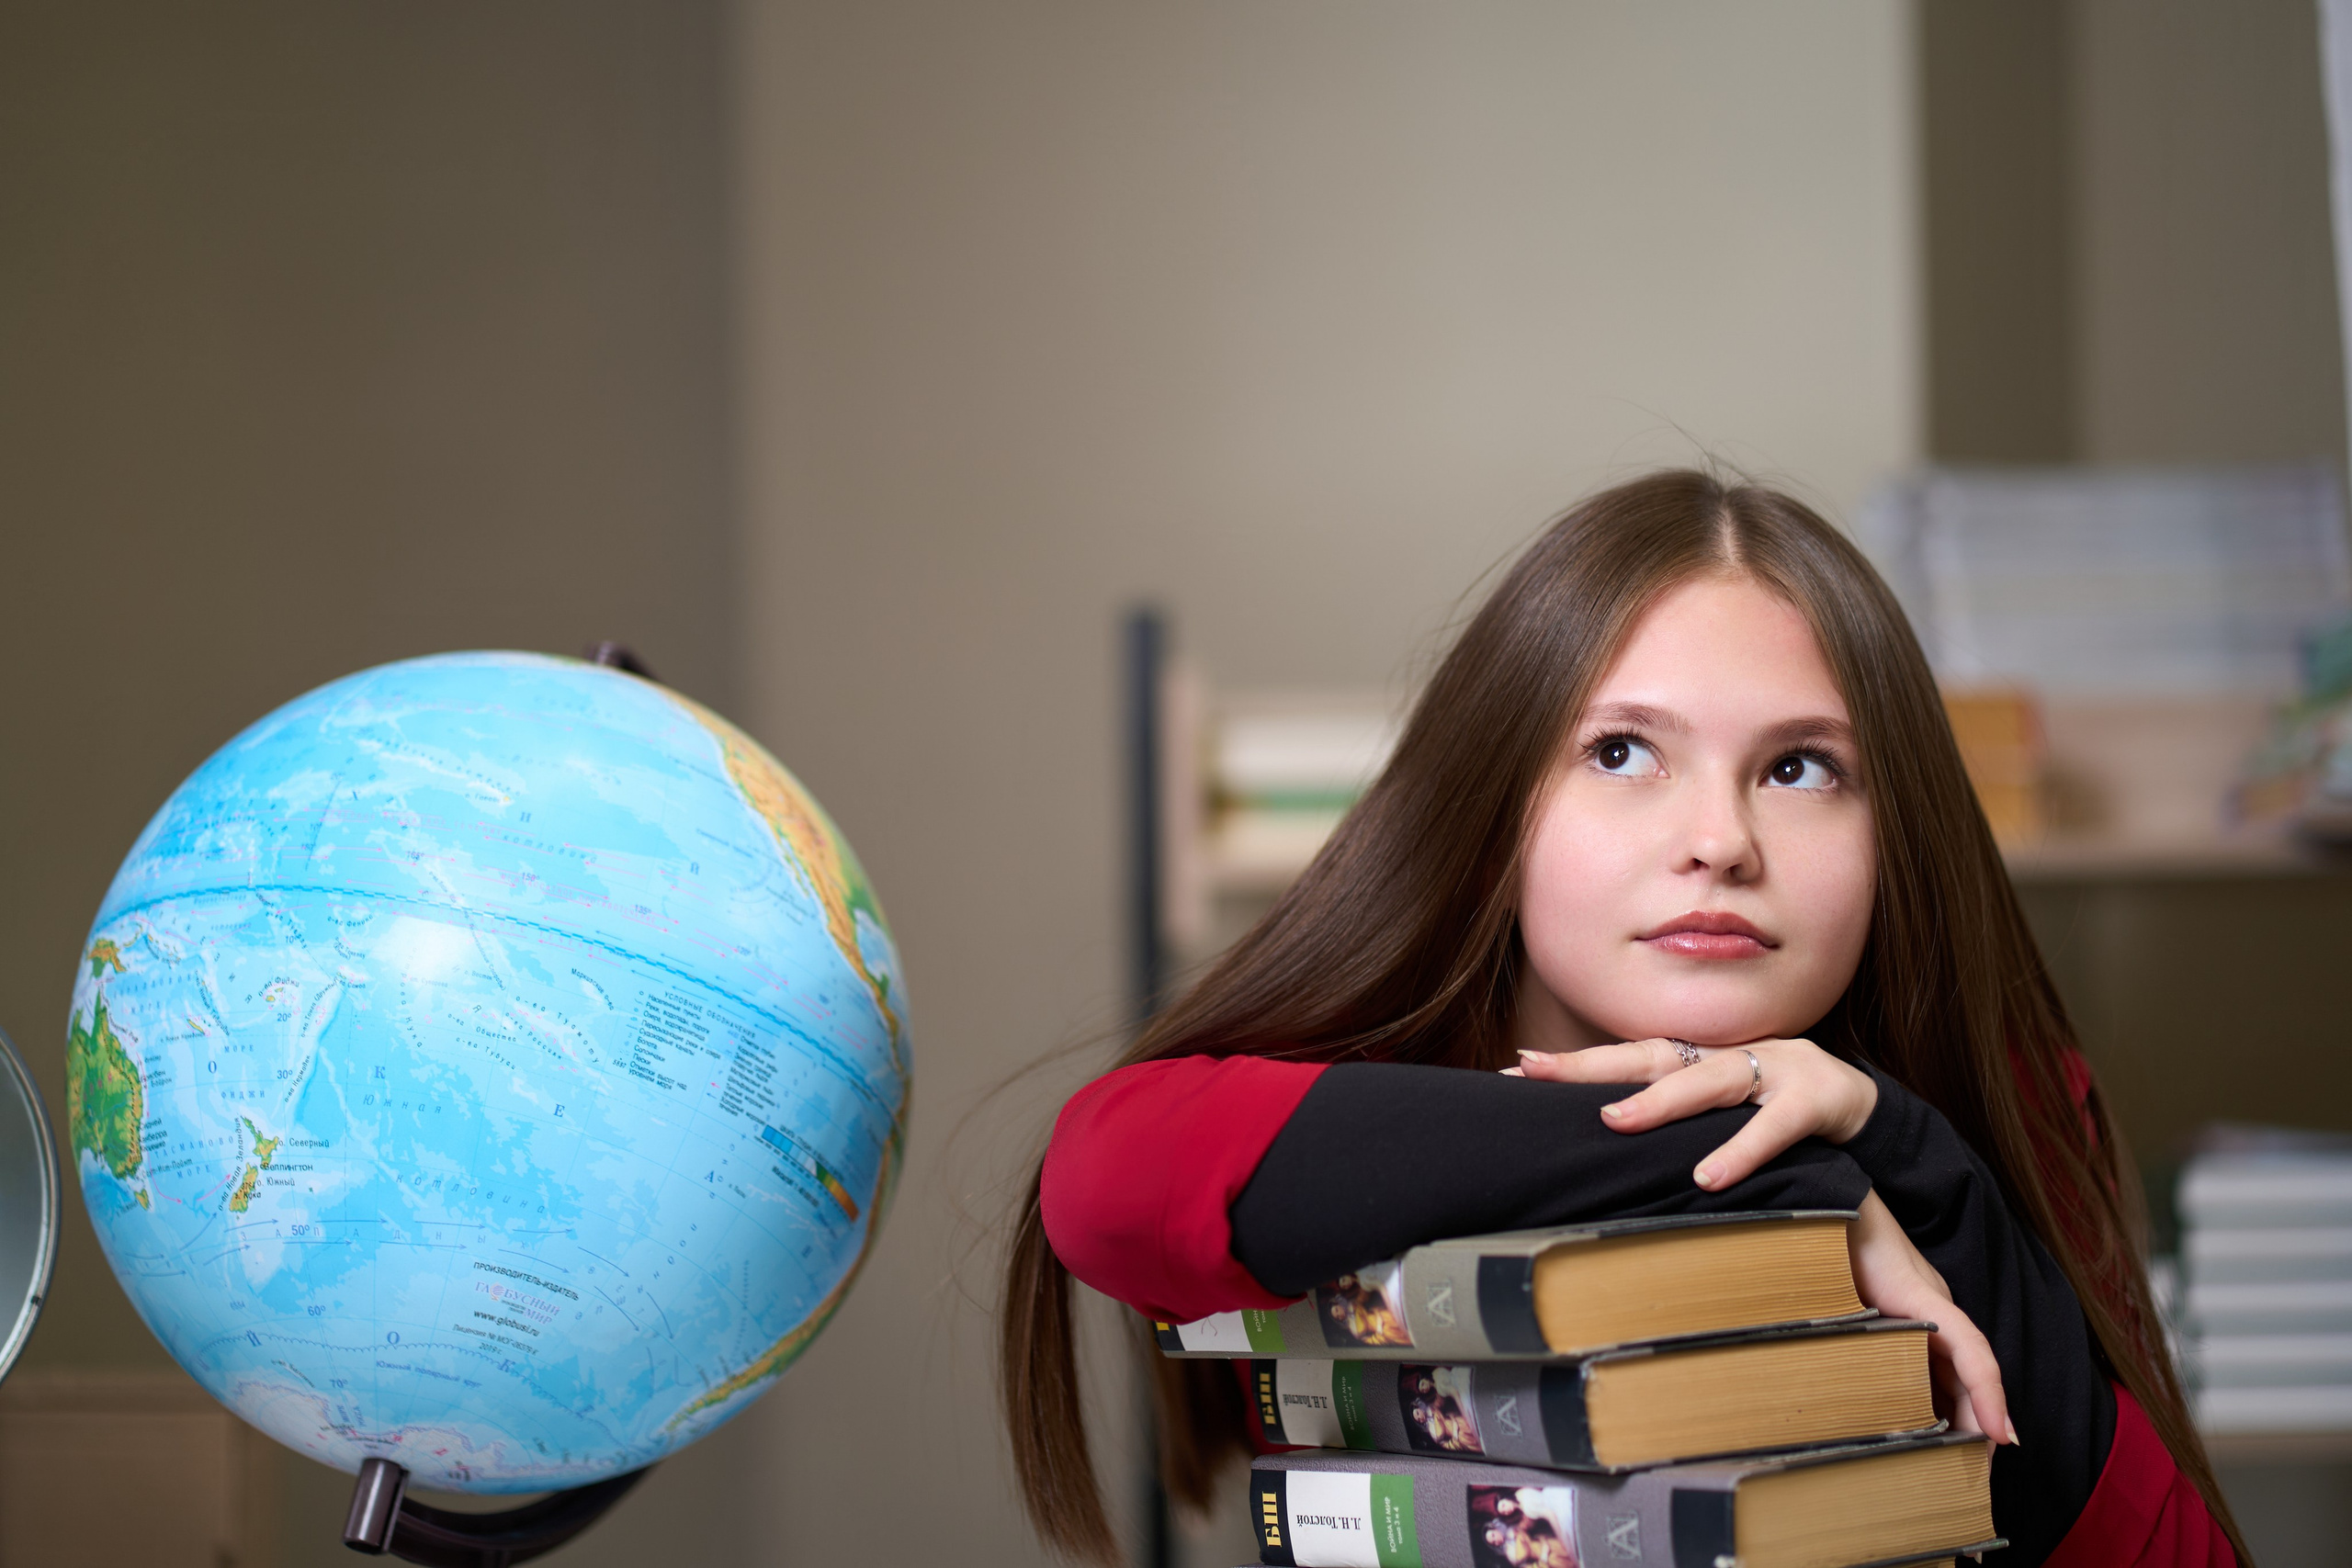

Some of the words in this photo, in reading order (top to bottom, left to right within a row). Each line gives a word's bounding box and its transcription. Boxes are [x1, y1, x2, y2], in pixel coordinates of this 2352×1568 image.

[275, 976, 300, 988] Фиджи
[664, 991, 704, 1013] УСЛОВНЫЕ
[277, 1012, 292, 1022] 20°
[224, 1044, 254, 1054] МОРЕ
[637, 1035, 659, 1050] Болота
[632, 1053, 651, 1066] Пески
[634, 1043, 666, 1063] Солончаки
[277, 1069, 293, 1080] 30°
[220, 1089, 266, 1100] ФИДЖИ
[363, 1094, 442, 1114] Южная
[154, 1135, 234, 1158] ТАСМАНОВО
[288, 1137, 330, 1149] Северный
[225, 1166, 243, 1191] Новая
[234, 1117, 244, 1163] Зеландия
[264, 1162, 314, 1172] Веллингтон
[266, 1176, 296, 1187] Южный
[396, 1174, 546, 1213] котловина
[291, 1224, 311, 1236] 50°
[473, 1261, 580, 1302] ПРОИЗВОДИТЕЛЬ-ИЗДАТЕЛЬ
[307, 1304, 326, 1316] 60°
[523, 1307, 553, 1325] МИР
[473, 1310, 540, 1337] www.globusi.ru
[452, 1324, 487, 1337] Лицензия
[479, 1342, 499, 1354] 2019
[376, 1359, 412, 1371] Южный
[414, 1367, 460, 1382] полярный
[463, 1379, 483, 1389] круг
[329, 1378, 348, 1389] 70°
[1261, 1491, 1283, 1548] БШ
[1388, 1525, 1397, 1552] ВОЙНА
